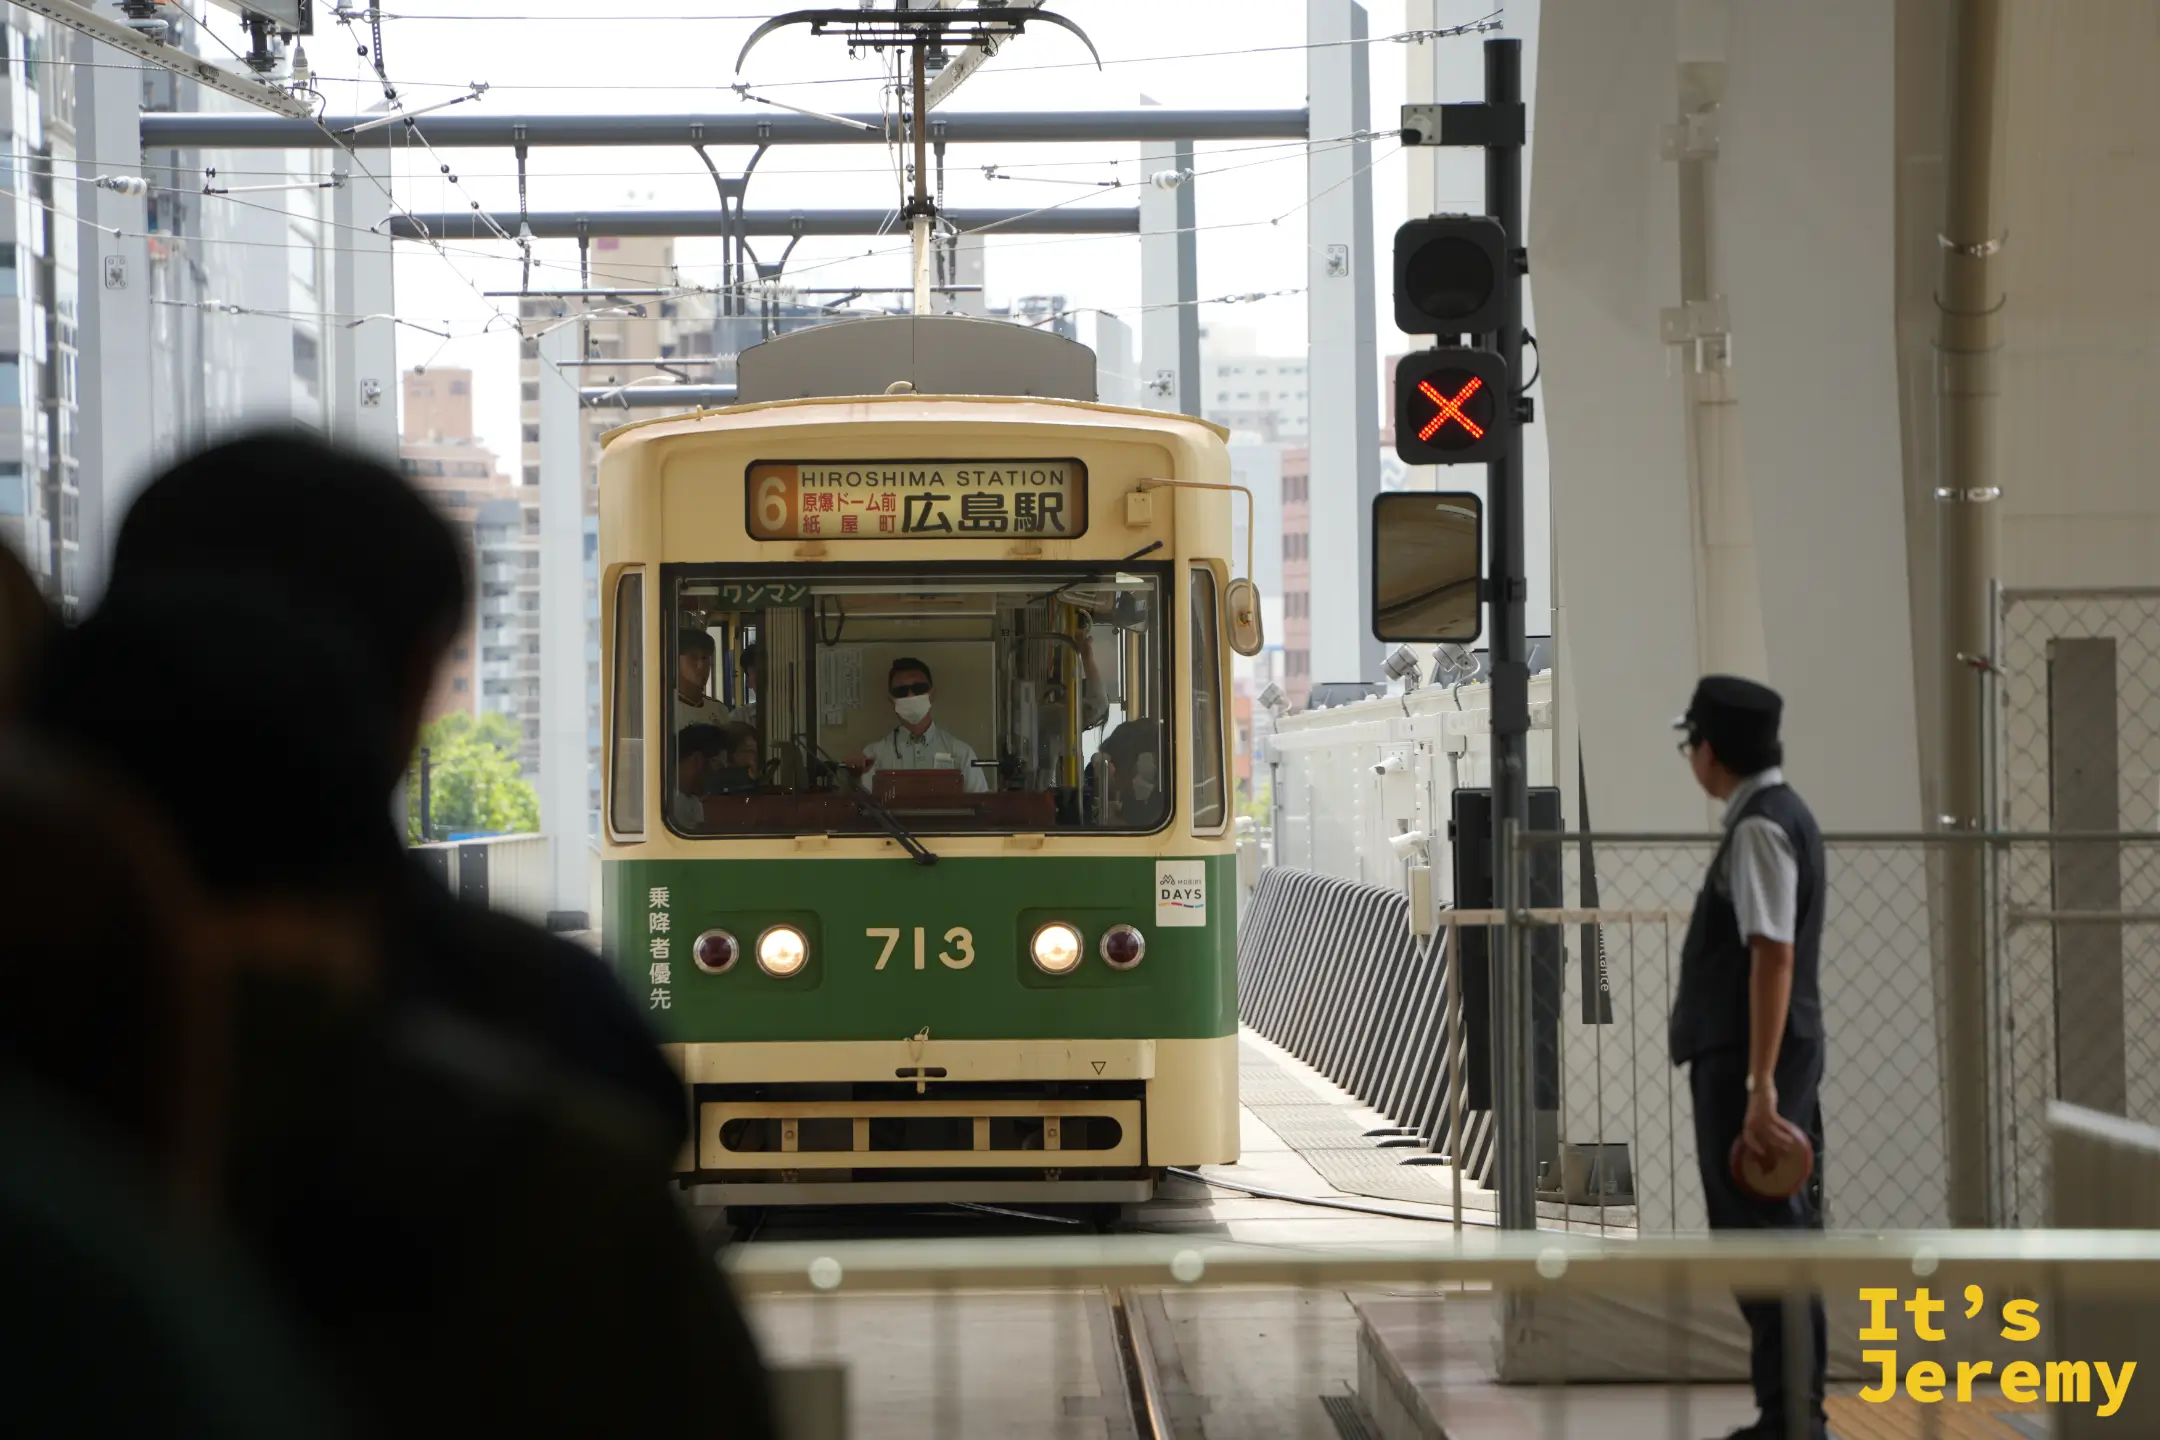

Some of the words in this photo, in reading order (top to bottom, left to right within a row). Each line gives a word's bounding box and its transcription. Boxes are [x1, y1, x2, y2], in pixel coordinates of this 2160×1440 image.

[802, 471, 945, 488] HIROSHIMA
[957, 470, 1065, 487] STATION
[757, 476, 788, 532] 6
[802, 491, 897, 513] 原爆ドーム前
[901, 491, 1066, 534] 広島駅
[802, 514, 897, 534] 紙屋町
[722, 583, 807, 604] ワンマン
[1161, 888, 1202, 900] DAYS
[648, 886, 672, 1010] 乗降者優先
[865, 926, 975, 970] 713
